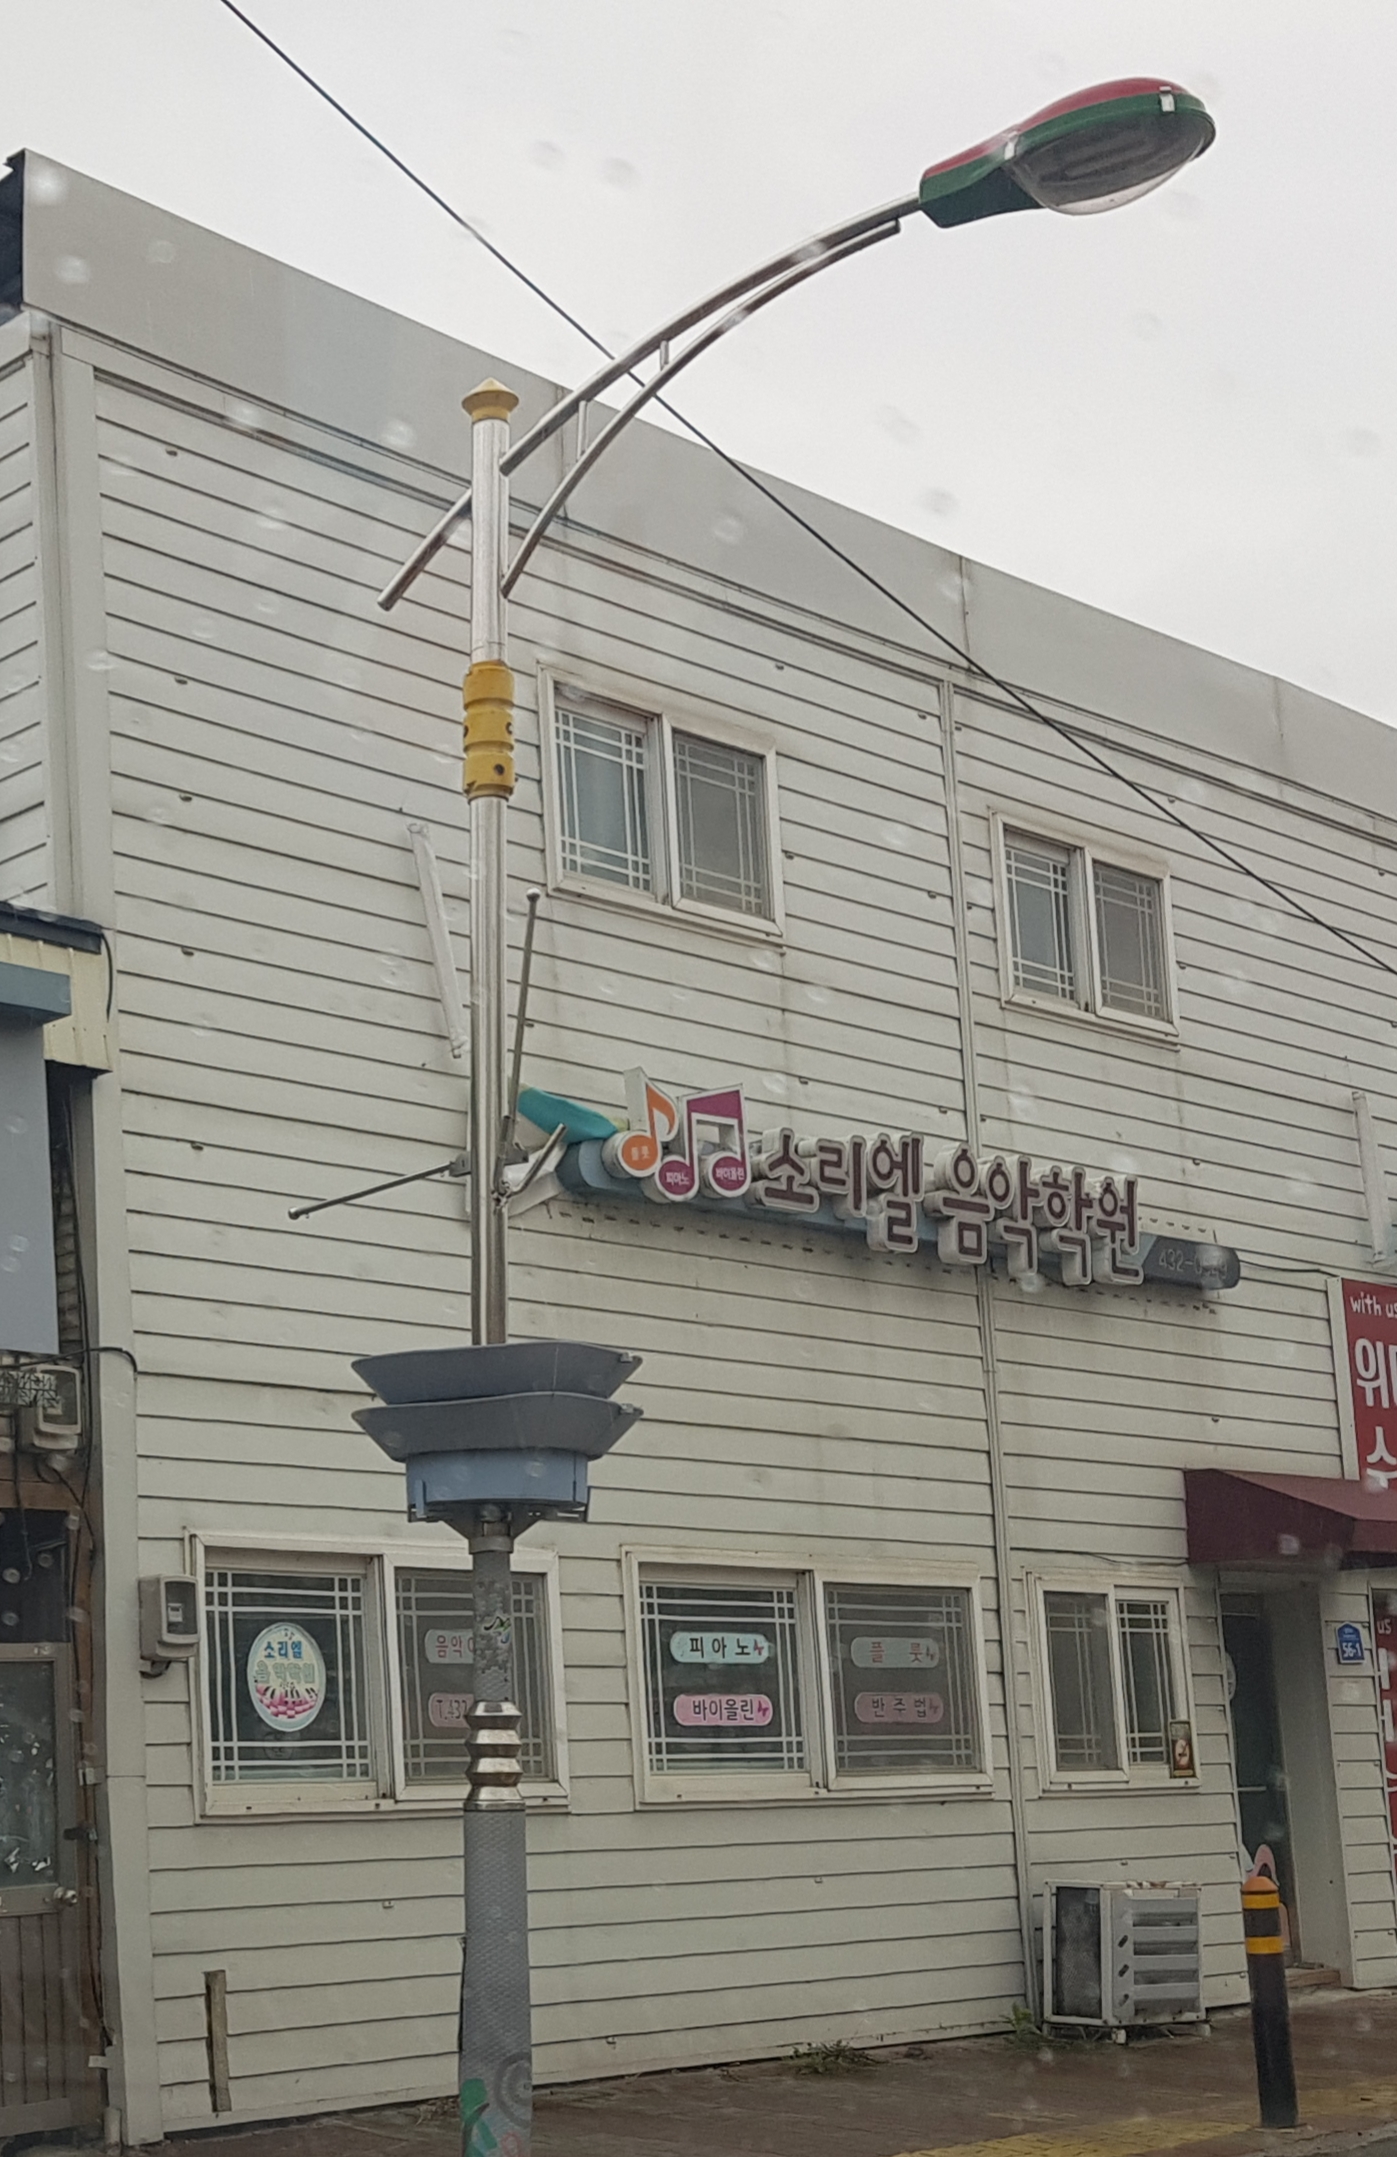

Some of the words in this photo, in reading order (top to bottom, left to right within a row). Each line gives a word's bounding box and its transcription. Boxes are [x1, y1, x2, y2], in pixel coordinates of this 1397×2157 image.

[665, 1171, 690, 1186] 피아노
[715, 1166, 745, 1181] 바이올린
[761, 1131, 923, 1249] 소리엘
[941, 1146, 1142, 1284] 음악학원
[1350, 1292, 1382, 1317] with
[1354, 1338, 1397, 1409] 위
[689, 1636, 751, 1659] 피아노
[692, 1699, 754, 1721] 바이올린
[871, 1697, 927, 1718] 반주법
